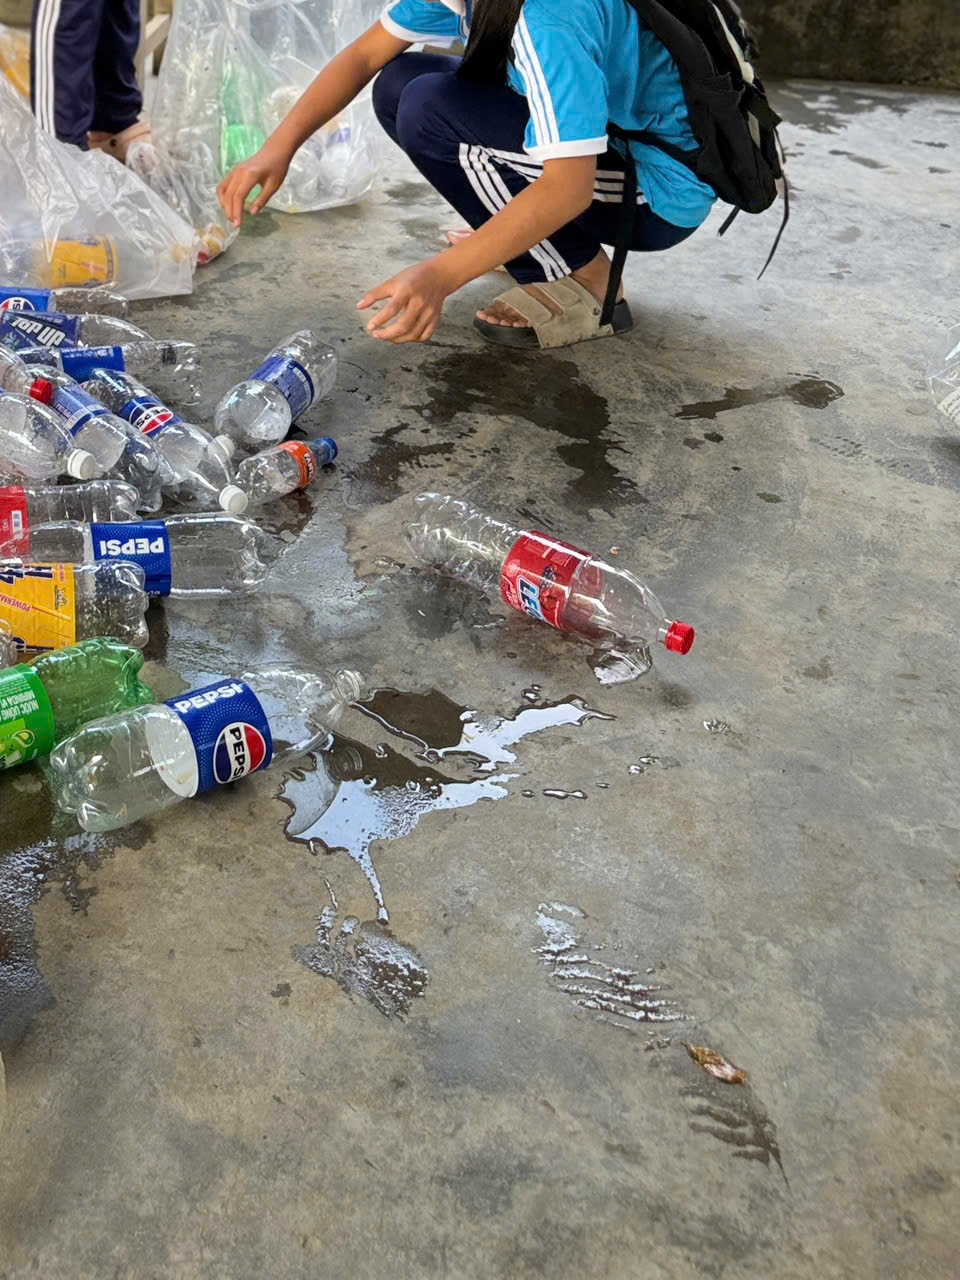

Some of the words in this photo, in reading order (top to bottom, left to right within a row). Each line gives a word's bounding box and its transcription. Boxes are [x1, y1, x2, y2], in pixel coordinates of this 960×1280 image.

[10, 316, 43, 335] TOP
[36, 326, 67, 348] UP
[99, 536, 166, 556] PEPSI
[0, 697, 9, 708] VỊ
[6, 689, 36, 707] MIRINDA
[19, 699, 40, 716] NƯỚC
[174, 682, 244, 714] PEPSI
[0, 705, 22, 723] UỐNG
[228, 726, 246, 781] PEPSI
